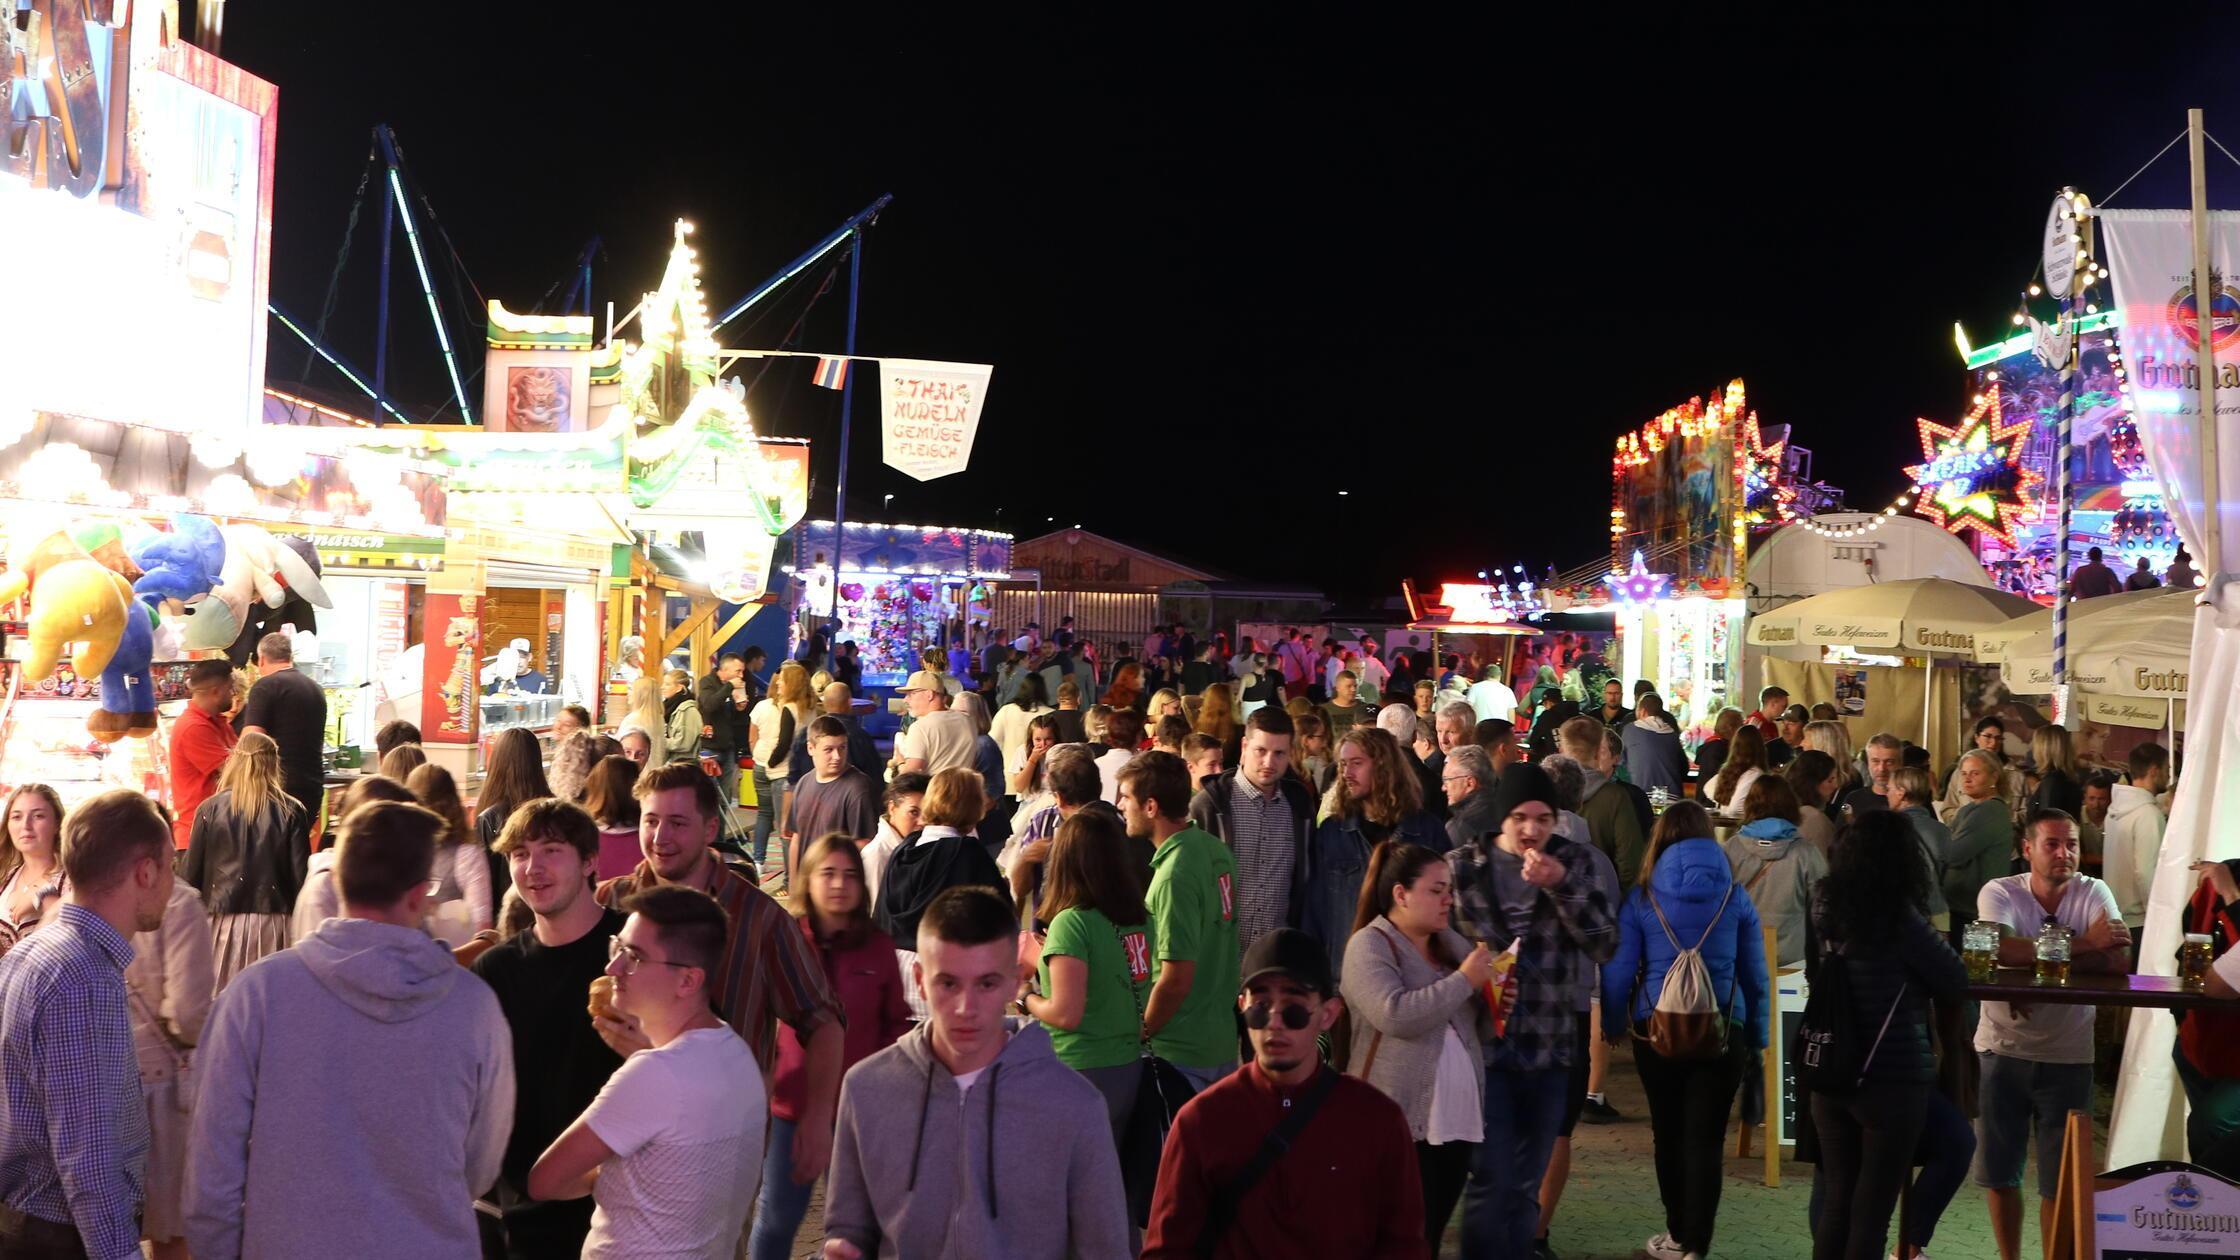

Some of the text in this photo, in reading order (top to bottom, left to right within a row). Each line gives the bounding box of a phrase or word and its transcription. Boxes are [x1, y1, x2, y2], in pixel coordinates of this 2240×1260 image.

[908, 379, 955, 401] THAI
[894, 401, 967, 423] NUDELN
[893, 424, 963, 442] GEMÜSE
[1811, 624, 1889, 641] Gutes Hefeweizen
